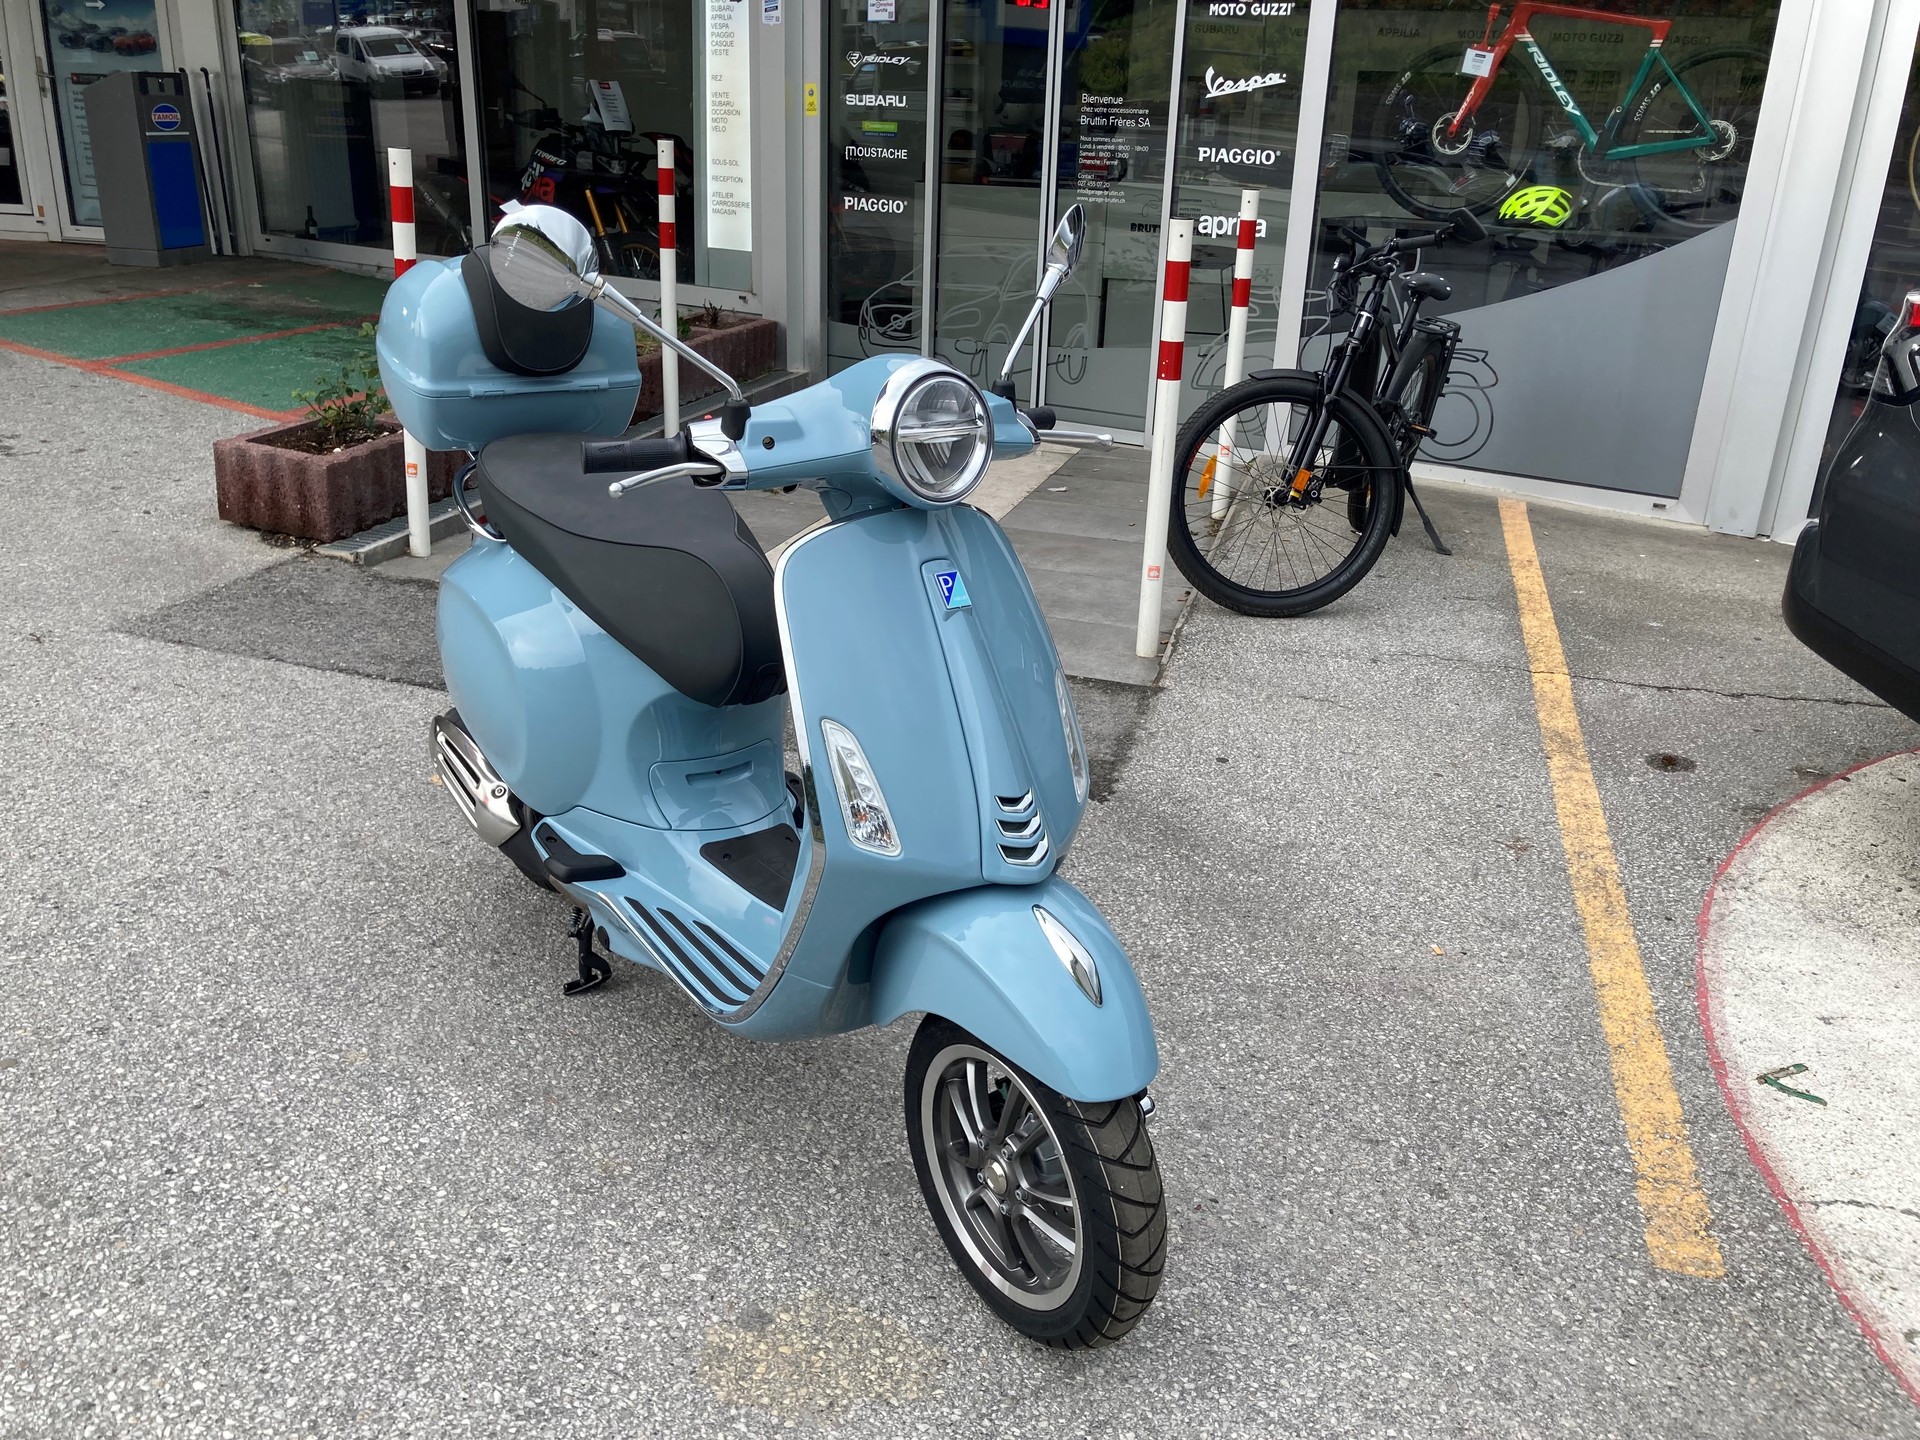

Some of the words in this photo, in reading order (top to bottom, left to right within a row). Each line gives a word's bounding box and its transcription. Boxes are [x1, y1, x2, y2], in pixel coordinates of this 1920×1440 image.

[1209, 3, 1246, 16] MOTO
[1251, 3, 1291, 16] GUZZI
[1552, 33, 1586, 42] MOTO
[862, 56, 910, 65] RIDLEY
[1205, 66, 1286, 98] Vespa
[1527, 46, 1582, 116] RIDLEY
[846, 94, 906, 107] SUBARU
[1082, 93, 1123, 104] Bienvenue
[1386, 83, 1402, 106] SWISS
[1634, 97, 1651, 121] SWISS
[1080, 115, 1107, 126] Bruttin
[1110, 116, 1135, 127] Frères
[1138, 117, 1150, 127] SA
[845, 146, 908, 160] MOUSTACHE
[1198, 147, 1276, 165] PIAGGIO
[712, 175, 743, 183] RECEPTION
[712, 200, 750, 208] CARROSSERIE
[844, 197, 904, 213] PIAGGIO
[1198, 212, 1267, 238] apria
[938, 576, 952, 596] P
